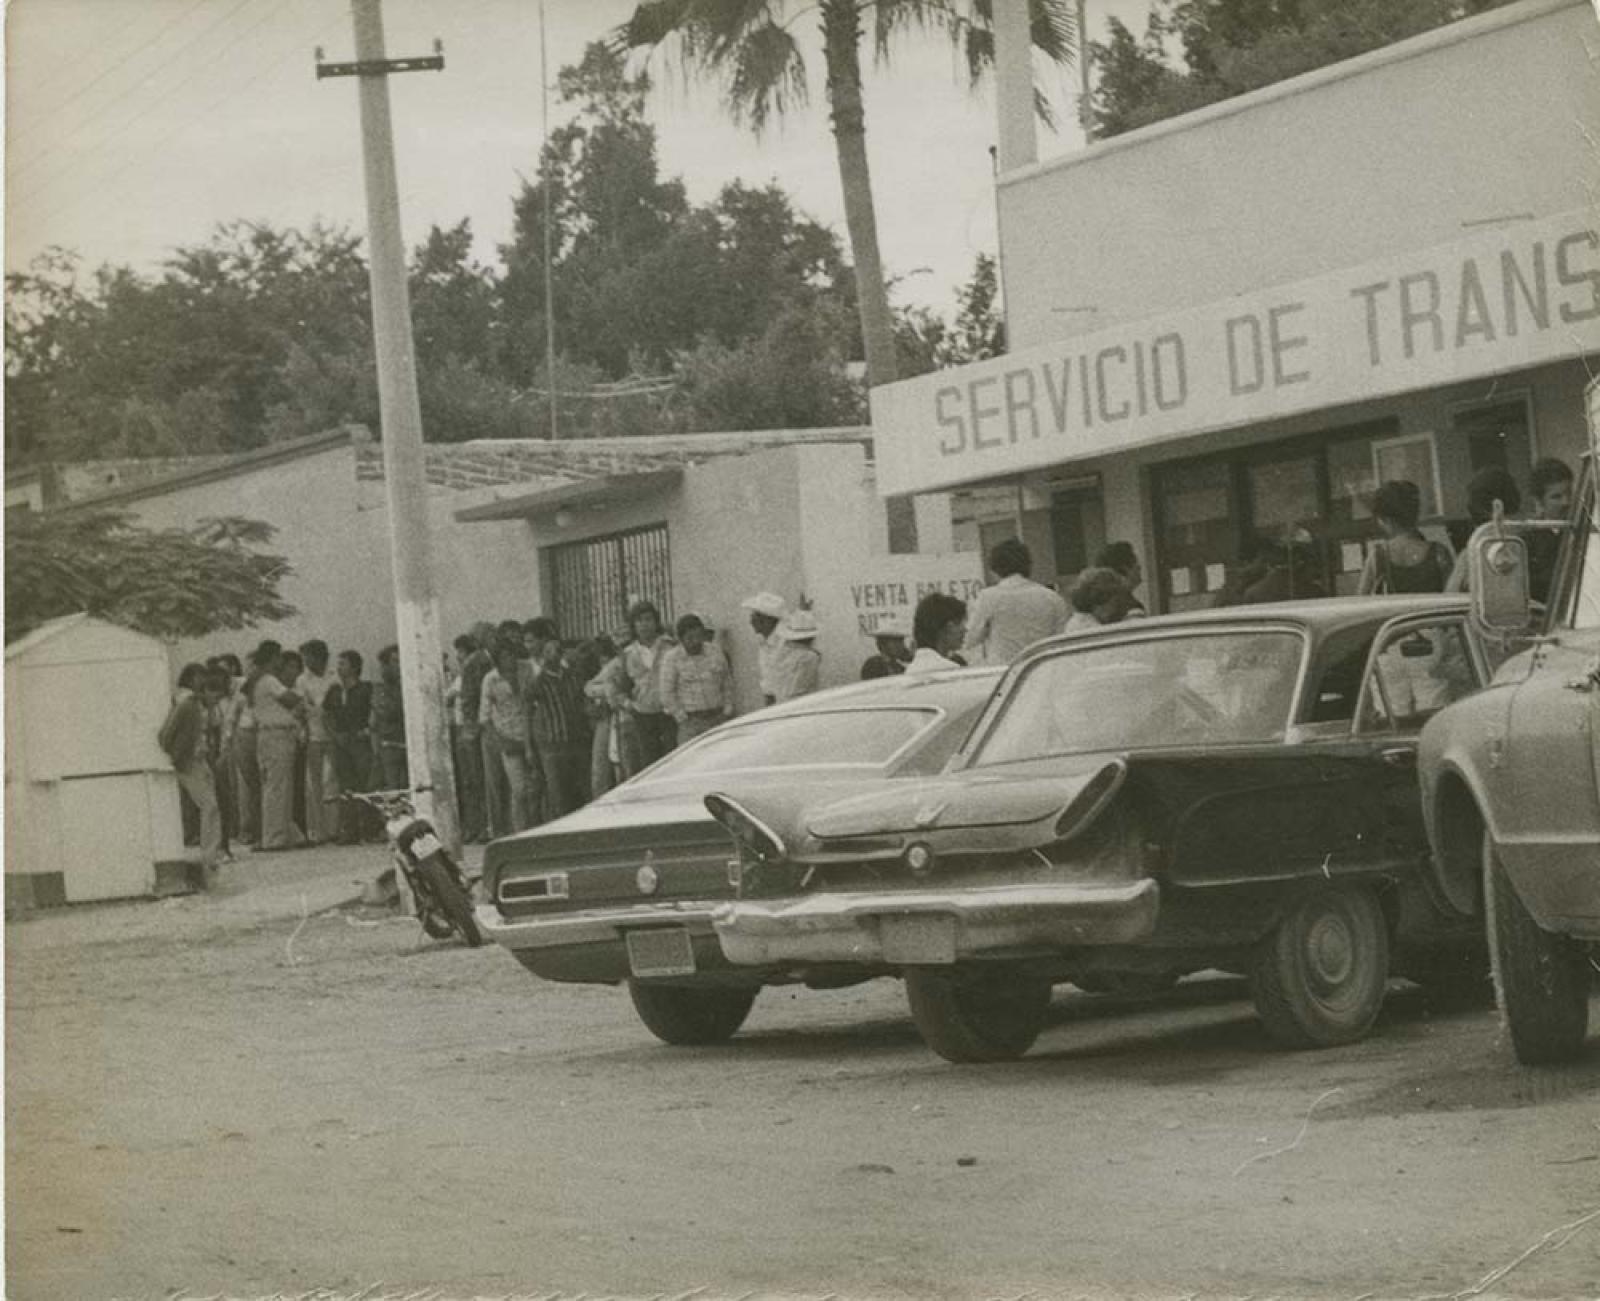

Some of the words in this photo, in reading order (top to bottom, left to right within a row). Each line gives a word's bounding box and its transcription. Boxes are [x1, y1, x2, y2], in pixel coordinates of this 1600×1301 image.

[935, 331, 1188, 457] SERVICIO
[1225, 302, 1310, 396] DE
[1351, 229, 1600, 367] TRANS
[850, 583, 909, 608] VENTA
